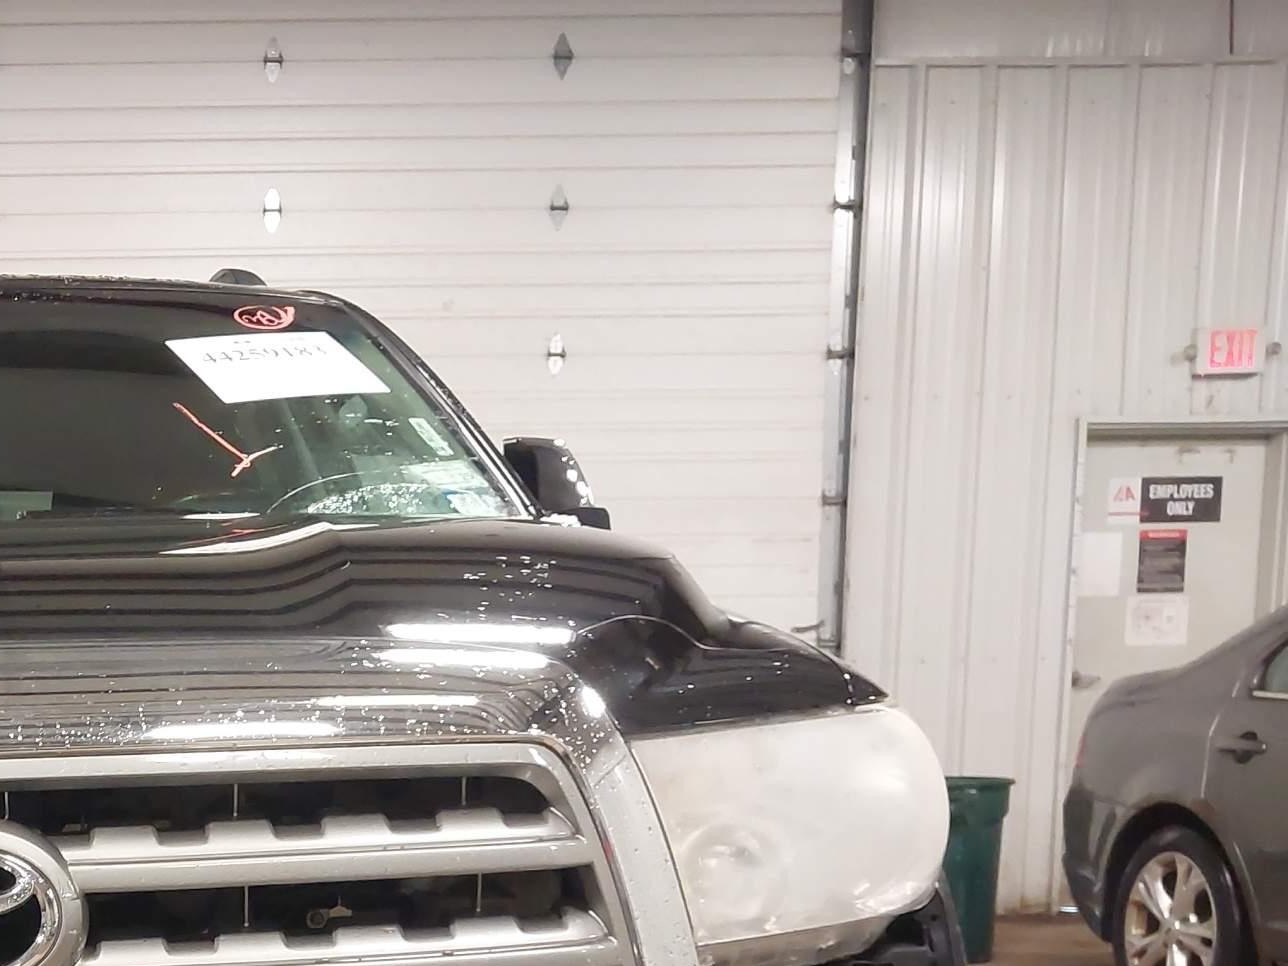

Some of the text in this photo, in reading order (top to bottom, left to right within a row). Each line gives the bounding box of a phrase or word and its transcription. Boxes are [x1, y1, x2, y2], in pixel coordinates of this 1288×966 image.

[1209, 329, 1257, 368] EXIT
[1149, 483, 1215, 500] EMPLOYEES
[1166, 500, 1196, 516] ONLY
